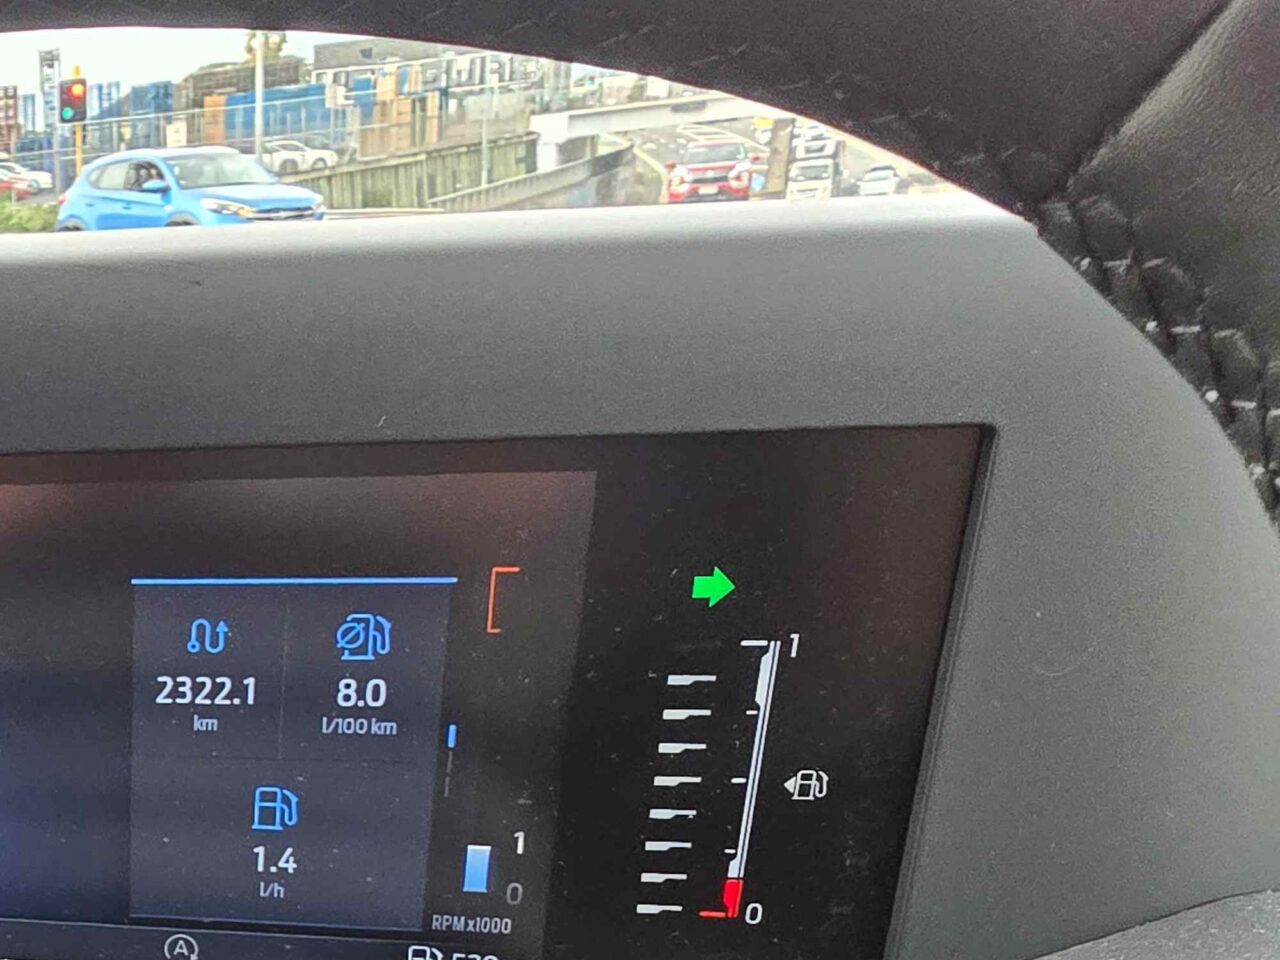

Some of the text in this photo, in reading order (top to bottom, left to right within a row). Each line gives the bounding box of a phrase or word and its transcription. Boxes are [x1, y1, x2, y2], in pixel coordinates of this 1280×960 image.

[789, 632, 801, 659] 1
[155, 676, 256, 705] 2322.1
[336, 678, 387, 707] 8.0
[193, 714, 218, 732] km
[370, 717, 397, 735] km
[513, 831, 525, 855] 1
[252, 845, 298, 874] 1.4
[744, 902, 763, 925] 0
